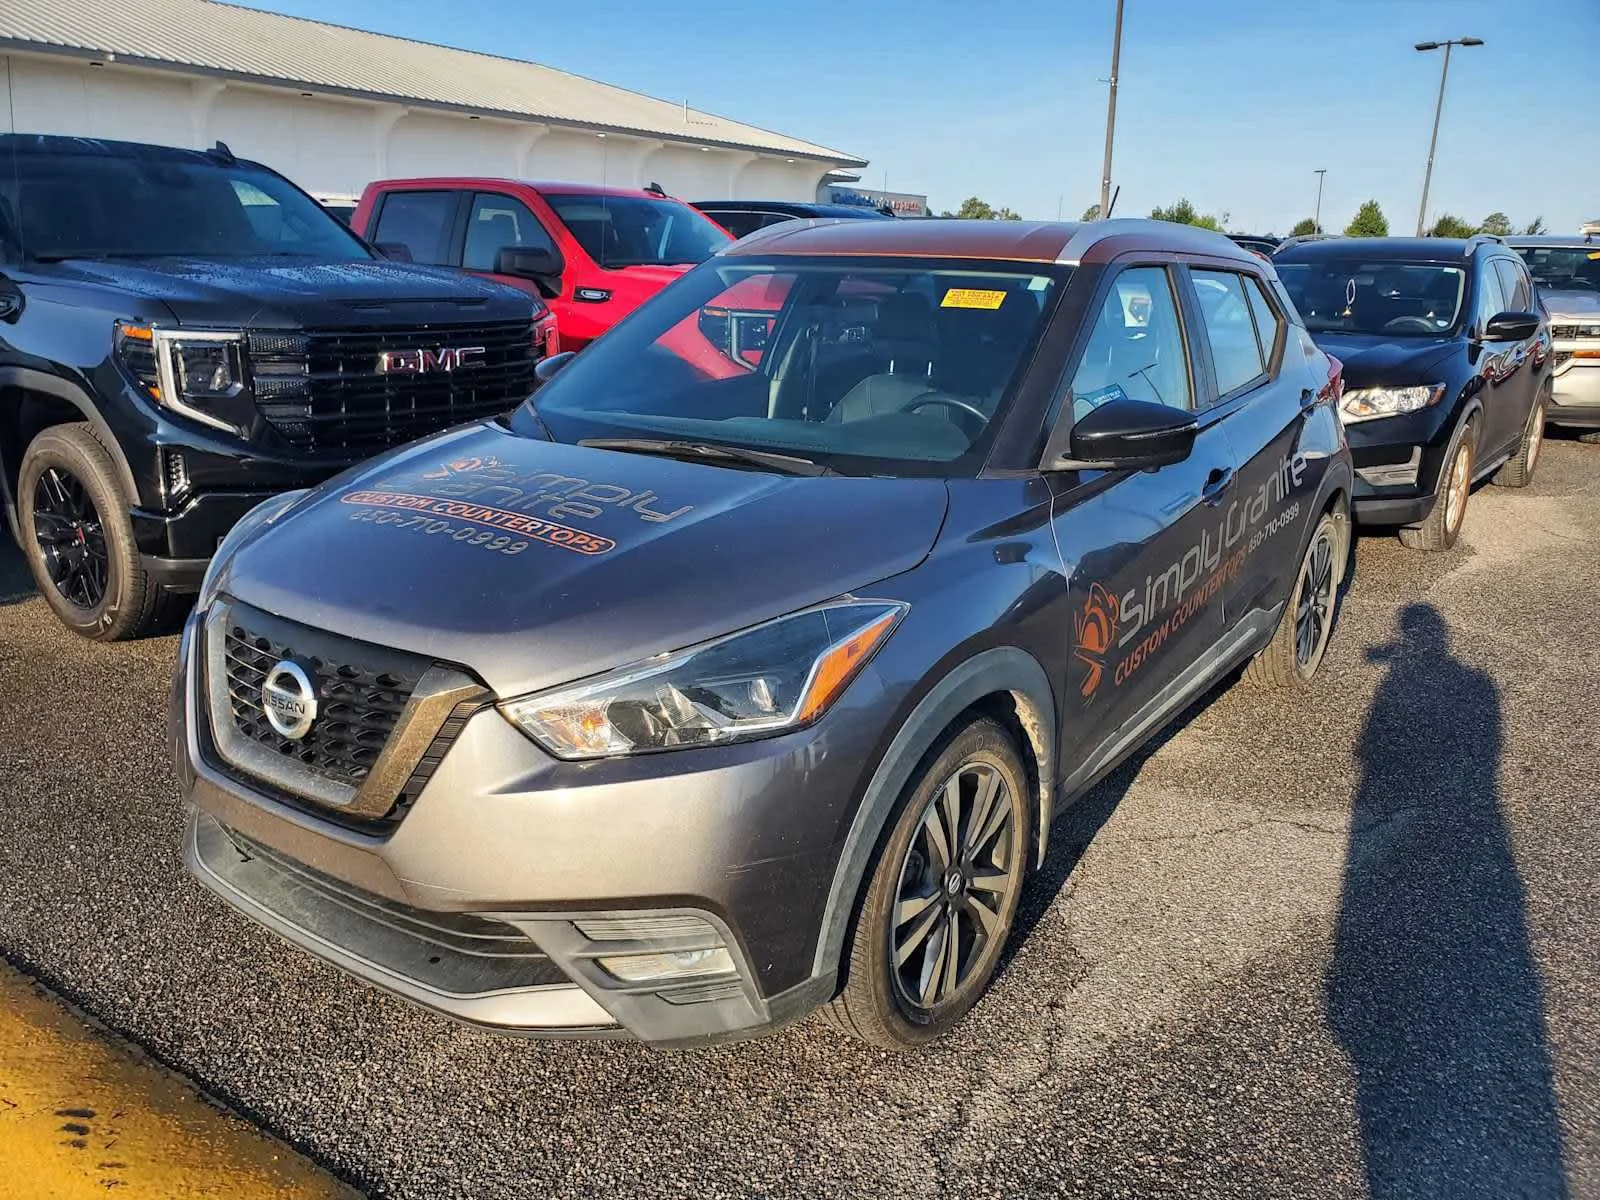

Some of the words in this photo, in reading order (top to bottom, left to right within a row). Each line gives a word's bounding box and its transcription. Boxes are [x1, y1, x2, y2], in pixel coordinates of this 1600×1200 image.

[382, 346, 486, 374] GMC
[350, 493, 433, 510] CUSTOM
[431, 501, 606, 552] COUNTERTOPS
[1114, 619, 1170, 687] CUSTOM
[1171, 544, 1247, 632] COUNTERTOPS
[262, 686, 306, 715] NISSAN
